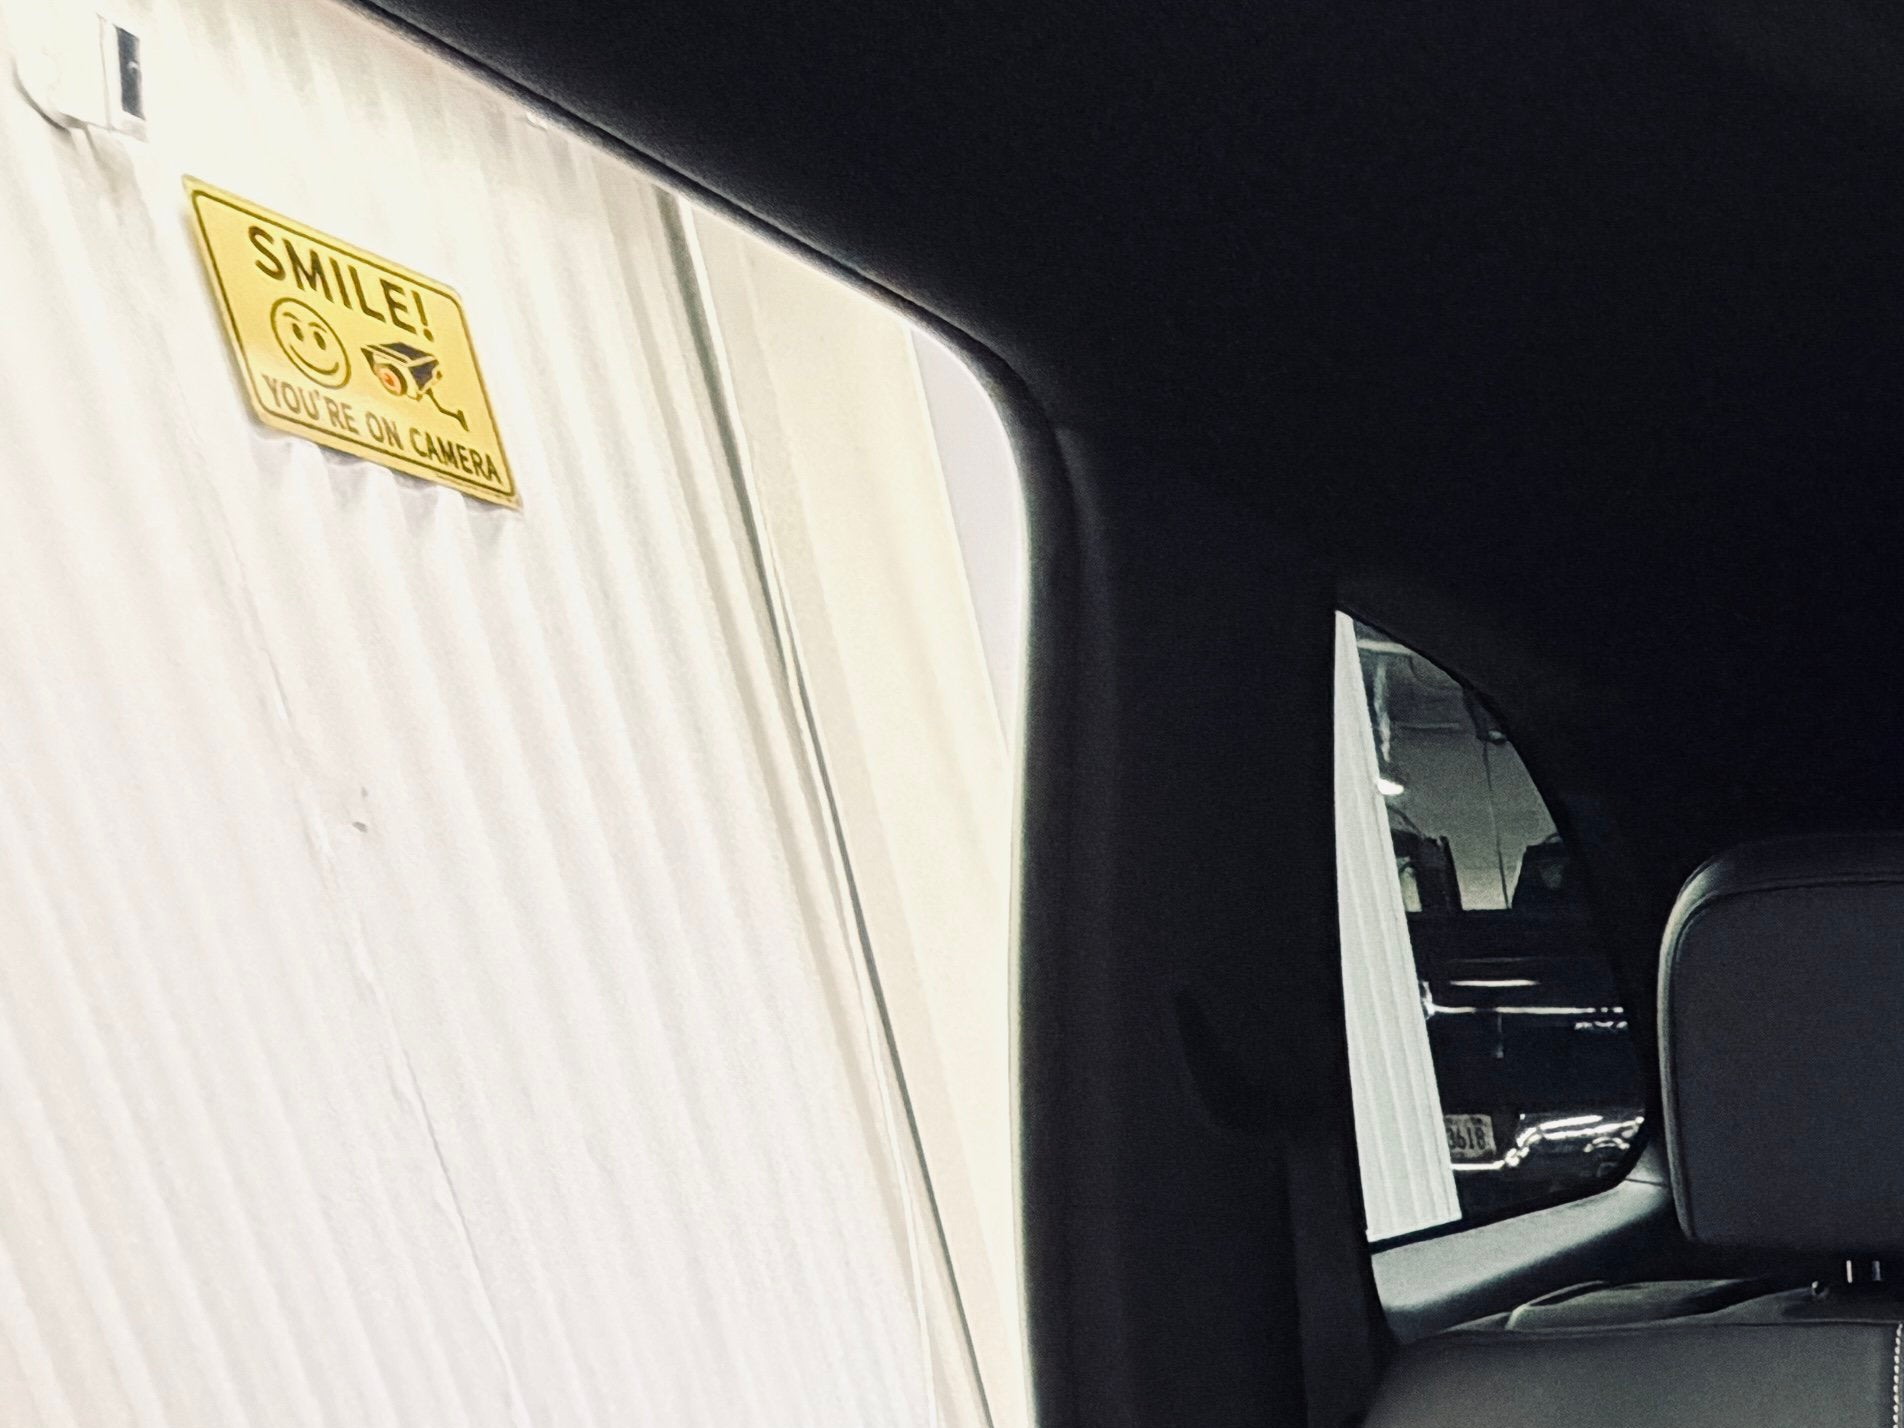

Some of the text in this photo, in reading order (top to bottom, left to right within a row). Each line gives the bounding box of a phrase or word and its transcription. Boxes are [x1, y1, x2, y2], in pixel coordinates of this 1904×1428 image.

[248, 225, 434, 342] SMILE!
[261, 373, 502, 484] YOU'RE ON CAMERA
